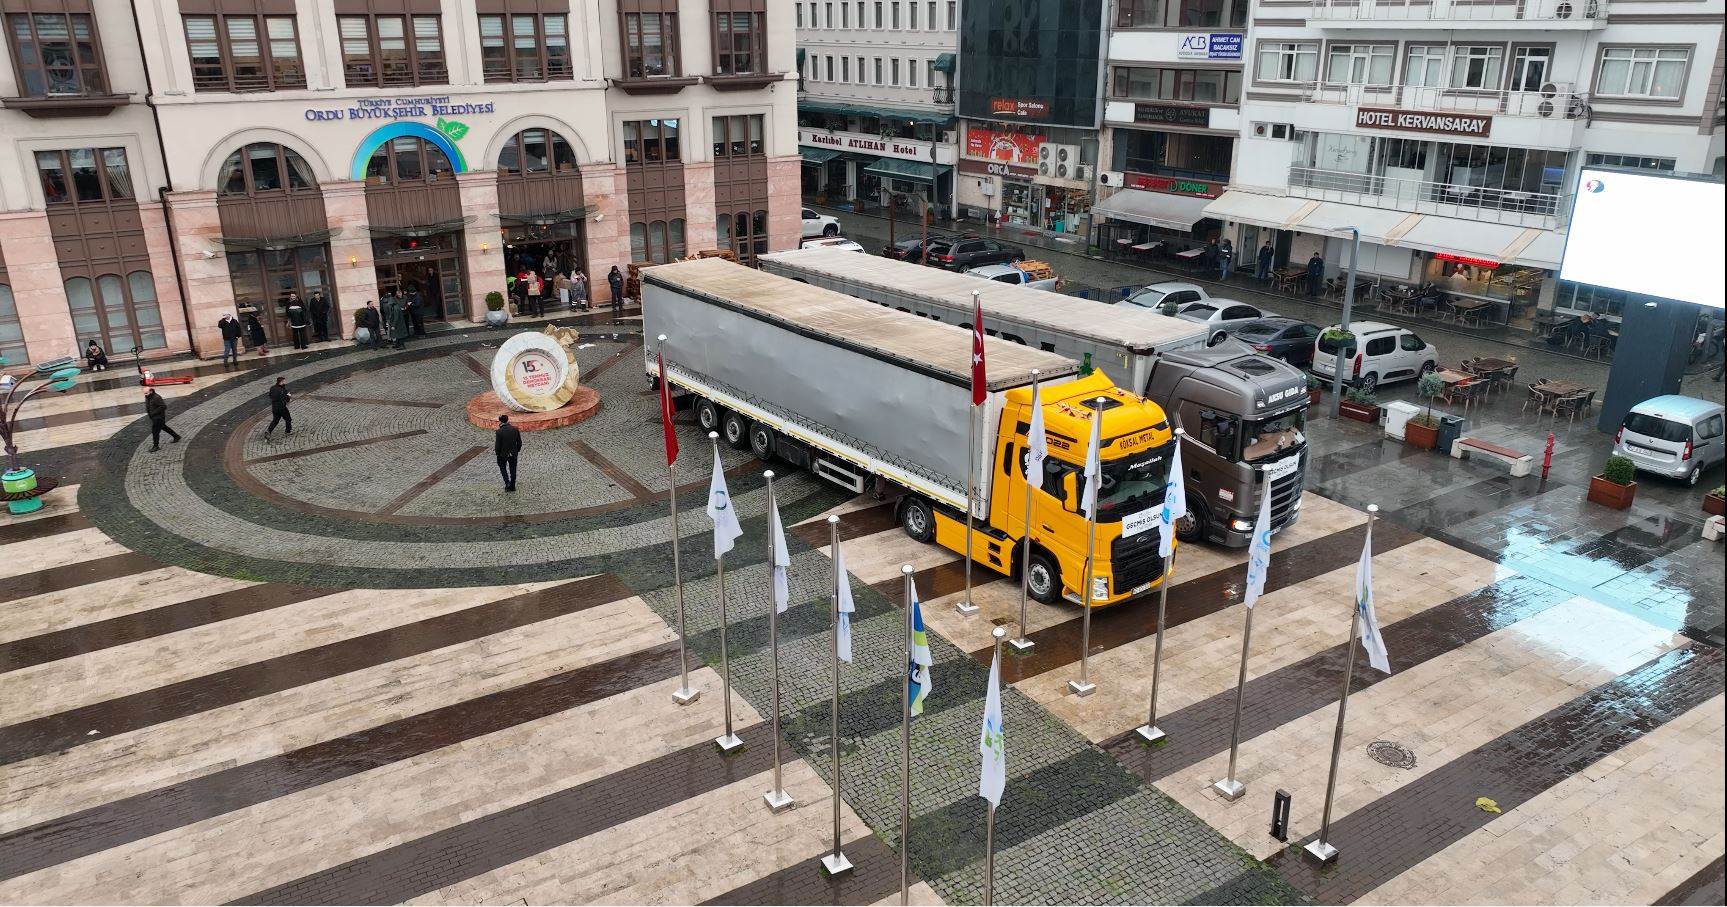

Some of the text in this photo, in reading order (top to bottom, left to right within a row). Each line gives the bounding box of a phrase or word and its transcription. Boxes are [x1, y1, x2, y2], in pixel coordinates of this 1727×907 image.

[357, 96, 450, 107] TÜRKİYE CUMHURİYETİ
[992, 99, 1015, 111] relax
[305, 101, 495, 121] ORDU BÜYÜKŞEHİR BELEDİYESİ
[1358, 111, 1487, 133] HOTEL KERVANSARAY
[848, 139, 886, 151] ATLIHAN
[893, 144, 917, 155] Hotel
[988, 163, 1010, 175] ORCA
[1180, 180, 1208, 193] DÖNER
[1268, 386, 1299, 404] AKSU GIDA
[1046, 436, 1071, 450] 022
[1119, 432, 1155, 450] KÖKSAL METAL
